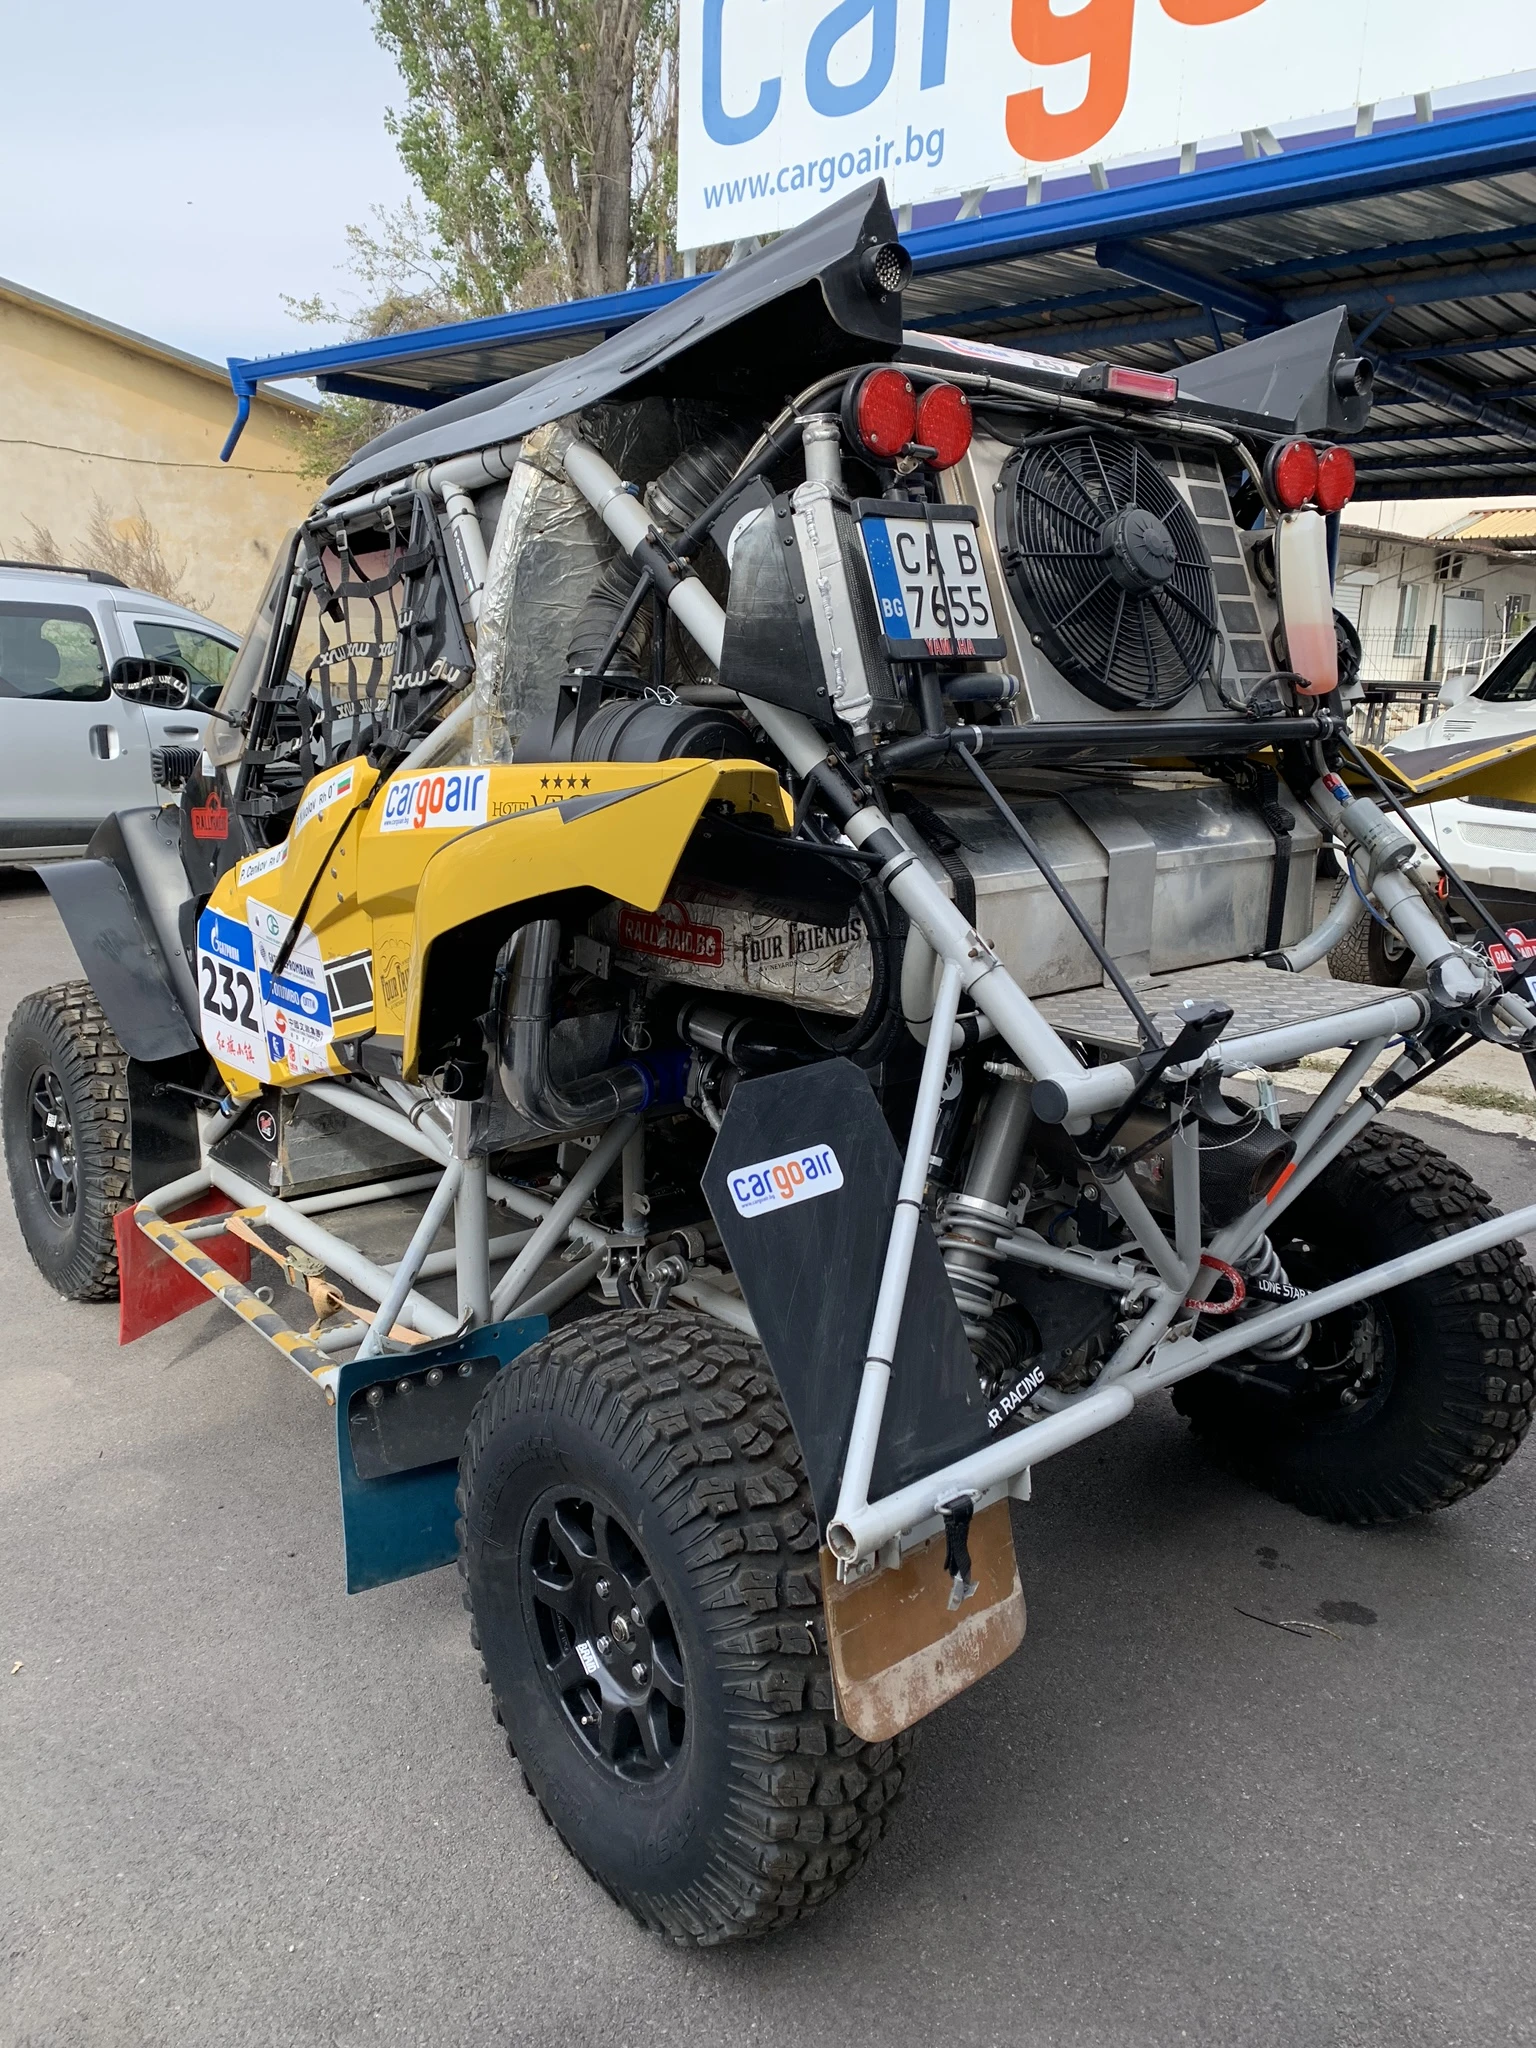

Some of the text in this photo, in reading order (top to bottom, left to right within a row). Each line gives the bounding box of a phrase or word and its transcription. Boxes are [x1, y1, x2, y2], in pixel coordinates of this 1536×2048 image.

[703, 124, 945, 210] www.cargoair.bg
[953, 534, 977, 575] B
[881, 598, 904, 618] BG
[905, 585, 989, 628] 7655
[924, 638, 976, 656] YAMHA
[385, 774, 484, 829] cargoair
[741, 916, 862, 970] FOUR FRIENDS
[202, 955, 260, 1034] 232
[732, 1151, 832, 1200] cargoair
[1258, 1279, 1281, 1295] LONE
[1282, 1284, 1306, 1300] STAR
[999, 1365, 1045, 1416] RACING
[577, 1641, 598, 1675] BRAID
